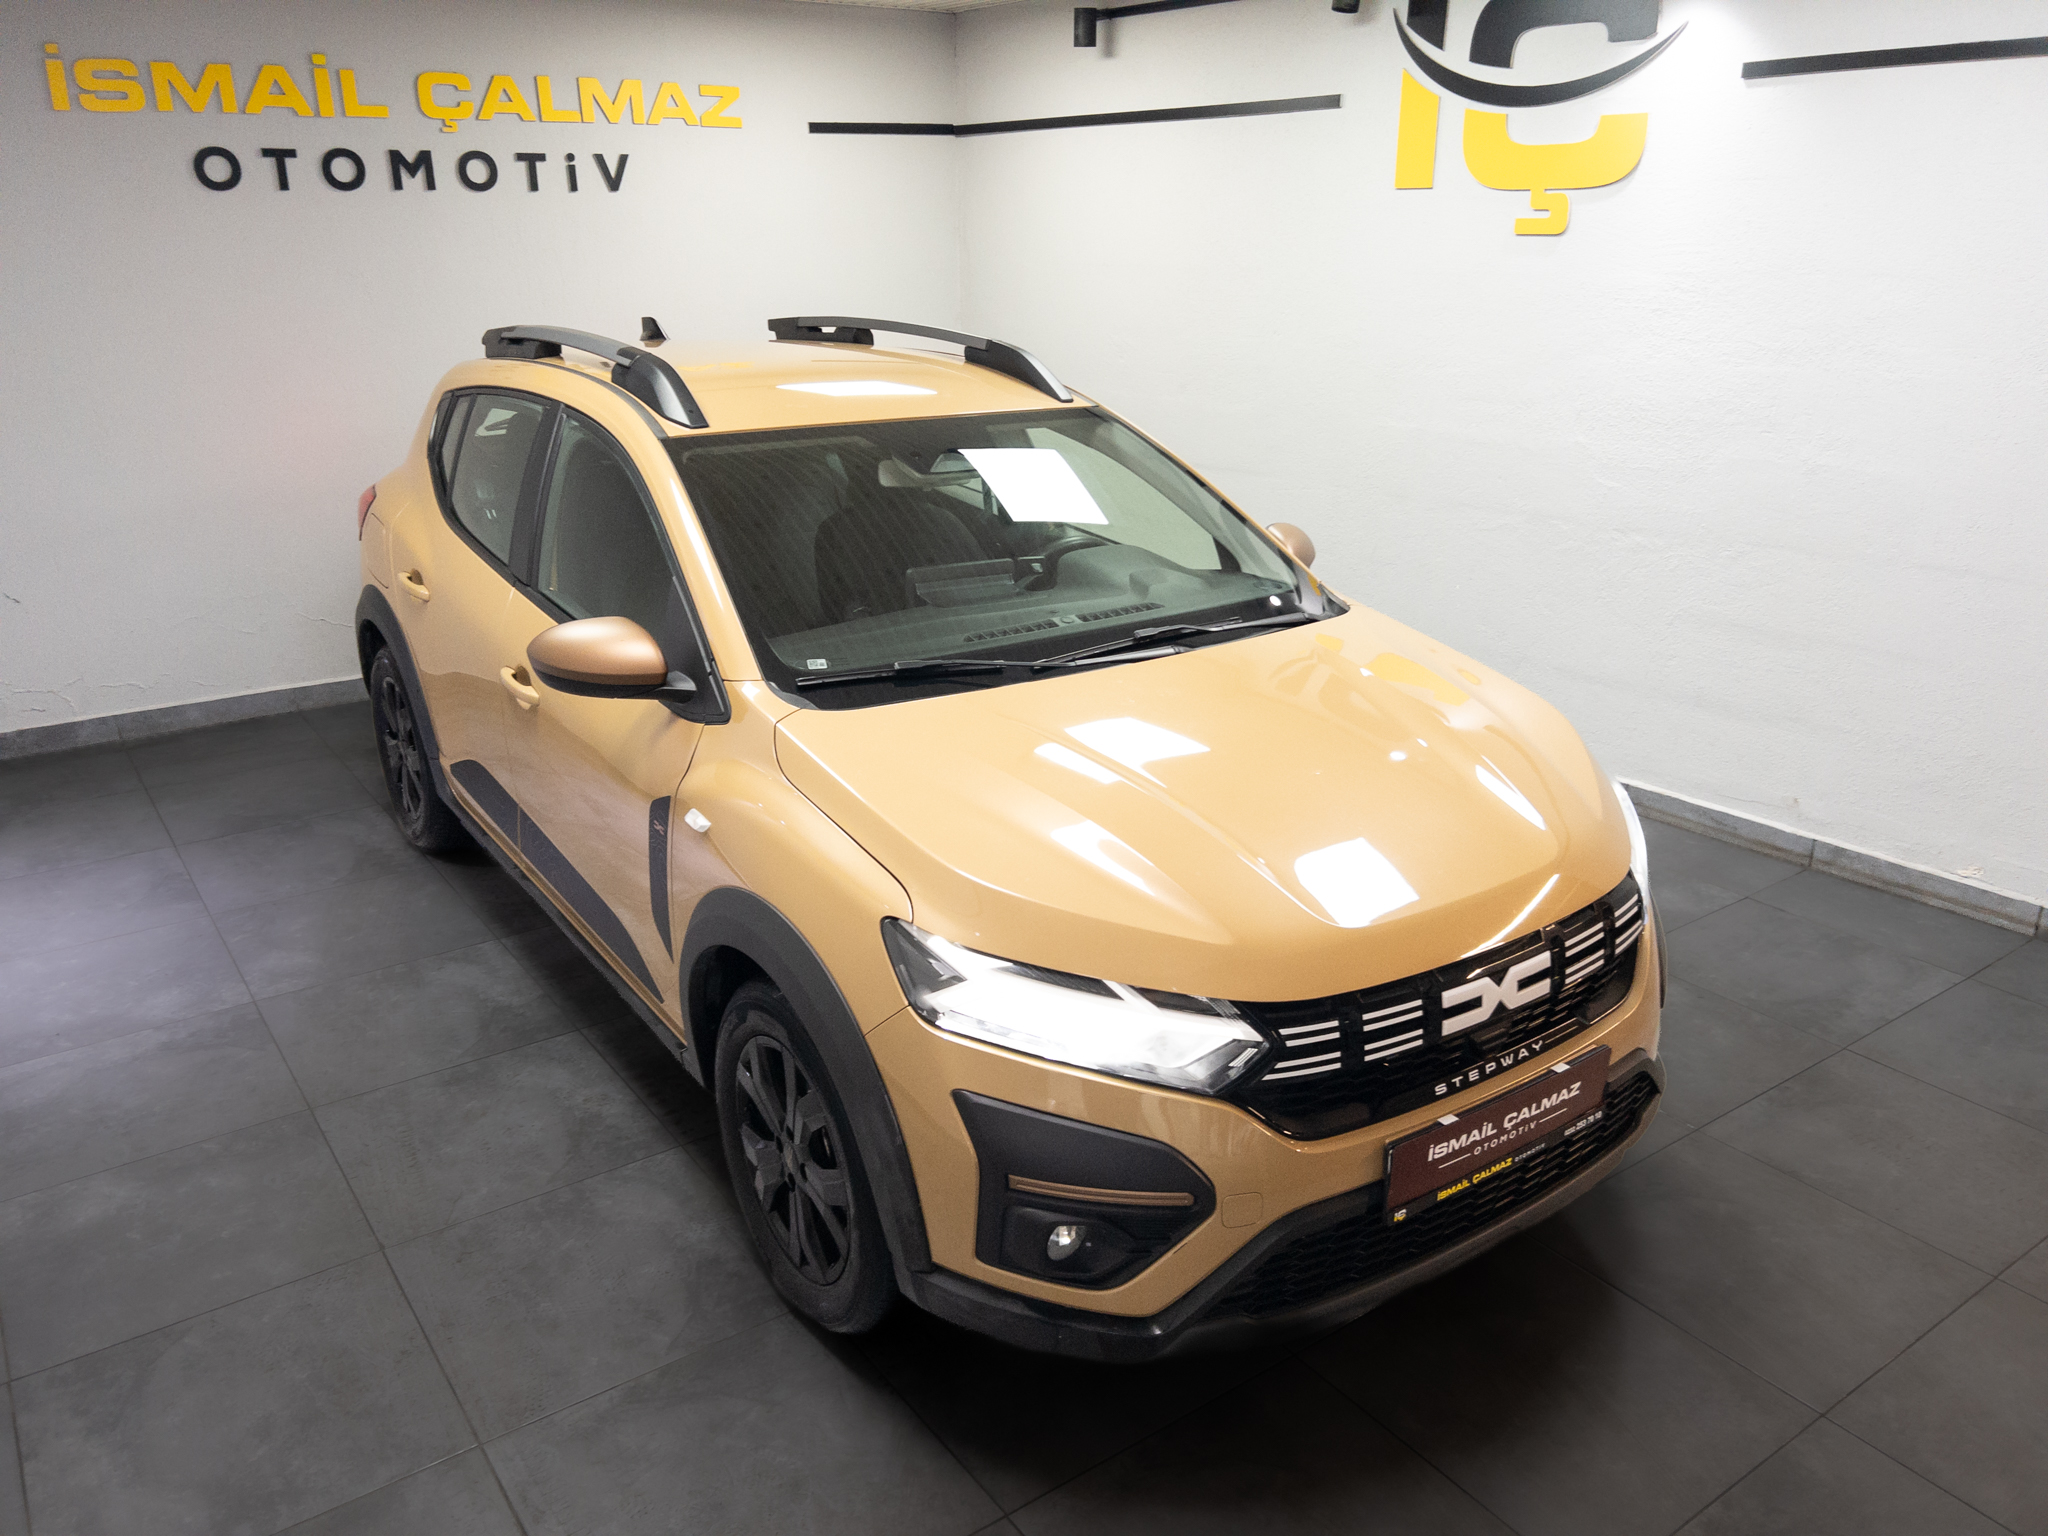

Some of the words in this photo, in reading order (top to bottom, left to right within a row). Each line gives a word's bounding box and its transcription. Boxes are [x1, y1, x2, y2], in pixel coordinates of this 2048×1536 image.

[44, 43, 390, 119] İSMAİL
[416, 70, 743, 133] ÇALMAZ
[1434, 1040, 1543, 1096] STEPWAY
[1427, 1121, 1498, 1162] İSMAİL
[1503, 1081, 1581, 1131] ÇALMAZ
[1472, 1157, 1513, 1184] ÇALMAZ
